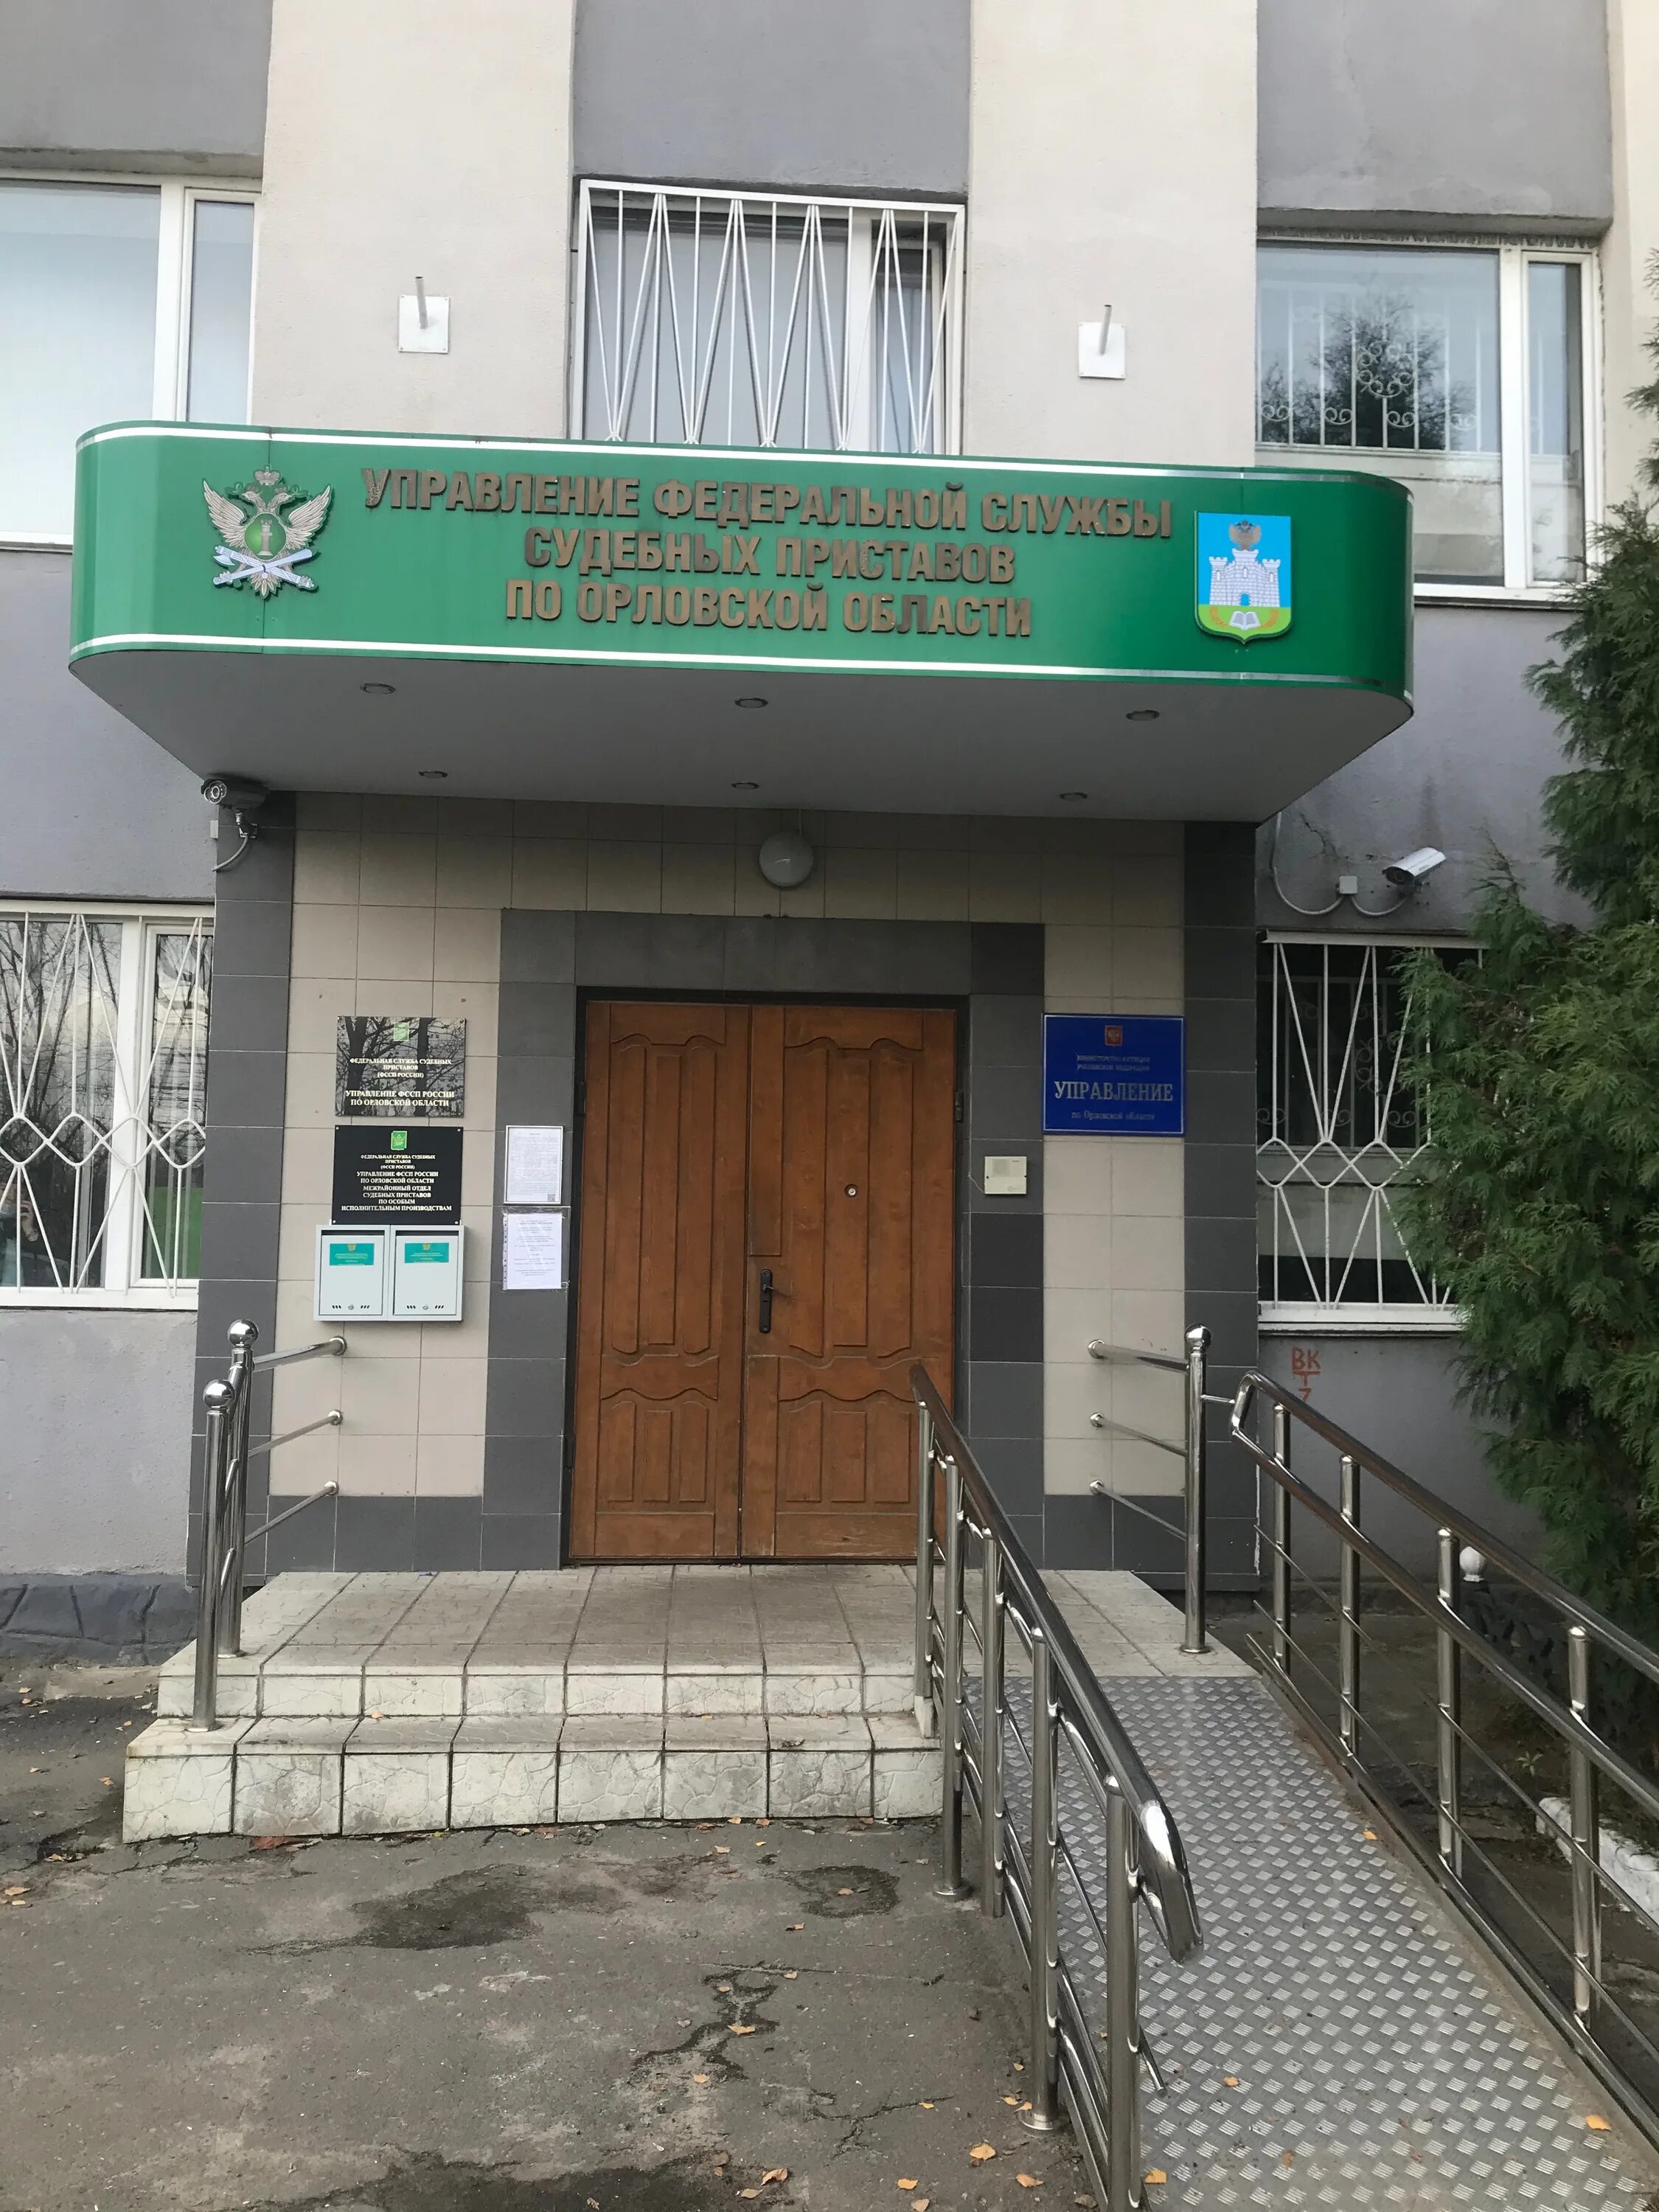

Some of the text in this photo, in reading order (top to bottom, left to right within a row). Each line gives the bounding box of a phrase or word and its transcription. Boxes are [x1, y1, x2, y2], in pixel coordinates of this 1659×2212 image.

[361, 468, 1172, 538] УПРАВЛЕНИЕ ФЕДЕРАЛЬНОЙ СЛУЖБЫ
[524, 526, 1016, 584] СУДЕБНЫХ ПРИСТАВОВ
[506, 579, 1031, 636] ПО ОРЛОВСКОЙ ОБЛАСТИ
[345, 1090, 397, 1098] УПРАВЛЕНИЕ
[1054, 1081, 1173, 1102] УПРАВЛЕНИЕ
